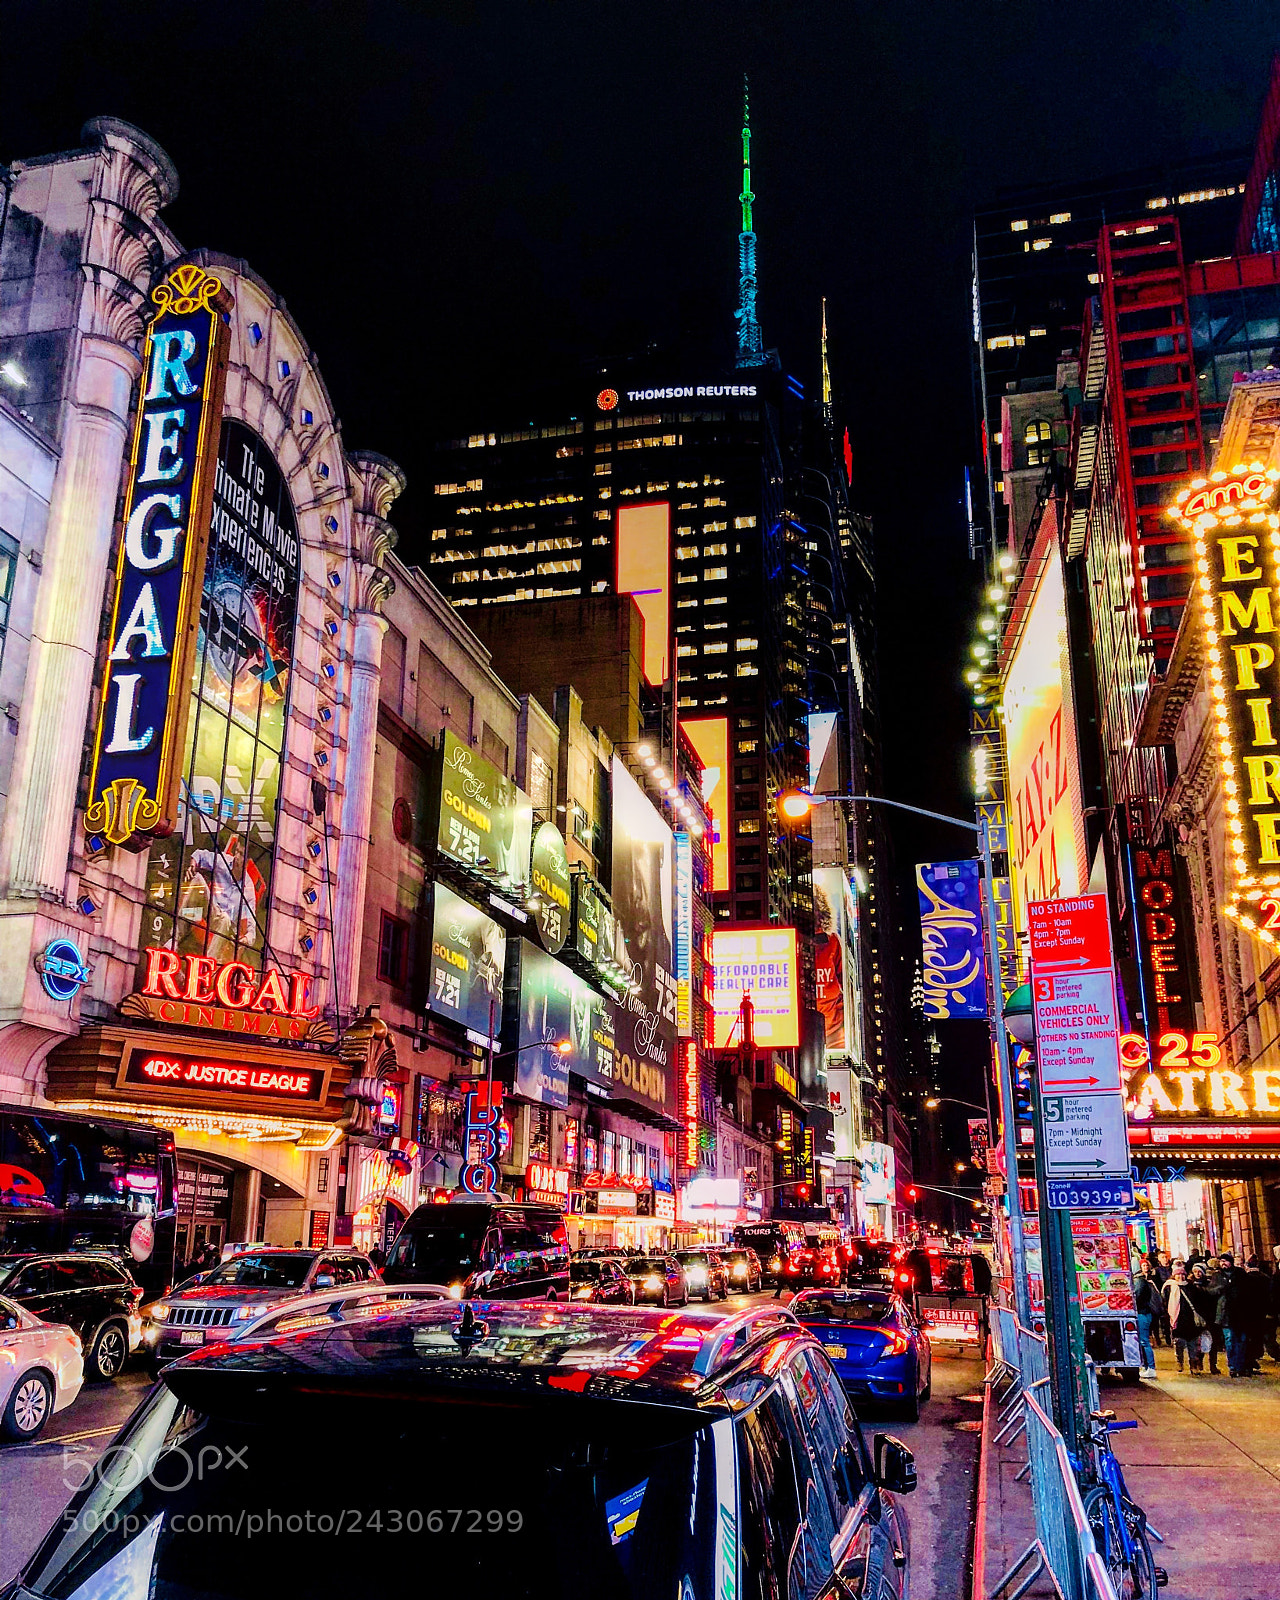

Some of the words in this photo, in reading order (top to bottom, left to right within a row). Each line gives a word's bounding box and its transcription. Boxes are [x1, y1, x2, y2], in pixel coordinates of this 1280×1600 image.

[627, 386, 694, 402] THOMSON
[696, 385, 757, 396] REUTERS
[241, 443, 265, 496] The
[1184, 474, 1266, 516] amc
[213, 457, 259, 529] timate
[262, 504, 297, 568] Movie
[104, 329, 200, 755] REGAL
[210, 501, 285, 595] xperiences
[1215, 535, 1280, 865] EMPIRE
[973, 711, 1006, 850] MAAME
[443, 789, 491, 834] GOLDEN
[449, 828, 480, 867] 7.21
[533, 869, 570, 912] GOLDEN
[1031, 905, 1045, 916] NO
[1047, 899, 1095, 915] STANDING
[1260, 899, 1280, 928] 2
[1032, 920, 1047, 929] 7am
[1053, 918, 1072, 927] 10am
[1033, 931, 1049, 940] 4pm
[1056, 928, 1071, 938] 7pm
[915, 863, 980, 1019] Aladdin
[1034, 939, 1058, 949] Except
[1060, 936, 1085, 947] Sunday
[432, 941, 469, 972] GOLDEN
[44, 954, 91, 983] RPX
[713, 963, 789, 976] AFFORDABLE
[816, 968, 833, 983] RY.
[142, 946, 320, 1019] REGAL
[713, 978, 754, 990] HEALTH
[759, 977, 789, 989] CARE
[1038, 979, 1051, 1000] 3
[1056, 983, 1083, 992] metered
[435, 979, 461, 1010] 7.21
[655, 979, 678, 1027] 7.21
[1056, 991, 1080, 1000] parking
[158, 1002, 302, 1039] CINEMAS
[1039, 1003, 1100, 1018] COMMERCIAL
[1040, 1017, 1084, 1030] VEHICLES
[1086, 1014, 1110, 1027] ONLY
[1041, 1033, 1068, 1043] OTHERS
[1069, 1032, 1079, 1041] NO
[1081, 1030, 1116, 1040] STANDING
[1042, 1047, 1060, 1056] 10am
[1067, 1046, 1083, 1057] 4pm
[1042, 1057, 1067, 1067] Except
[1068, 1055, 1095, 1066] Sunday
[1159, 1032, 1221, 1068] 25
[143, 1059, 180, 1079] 4DX:
[184, 1063, 249, 1087] JUSTICE
[250, 1071, 311, 1093] LEAGUE
[597, 1055, 613, 1079] 7.21
[614, 1049, 666, 1104] GOLDEN
[1141, 1070, 1280, 1113] ATRE
[1046, 1099, 1060, 1122] 5
[1065, 1105, 1093, 1113] metered
[1065, 1112, 1090, 1121] parking
[1048, 1128, 1064, 1138] 7pm
[1071, 1127, 1103, 1138] Midnight
[1049, 1138, 1073, 1148] Except
[1075, 1137, 1102, 1148] Sunday
[1050, 1191, 1112, 1205] 103939
[938, 1310, 976, 1321] RENTAL
